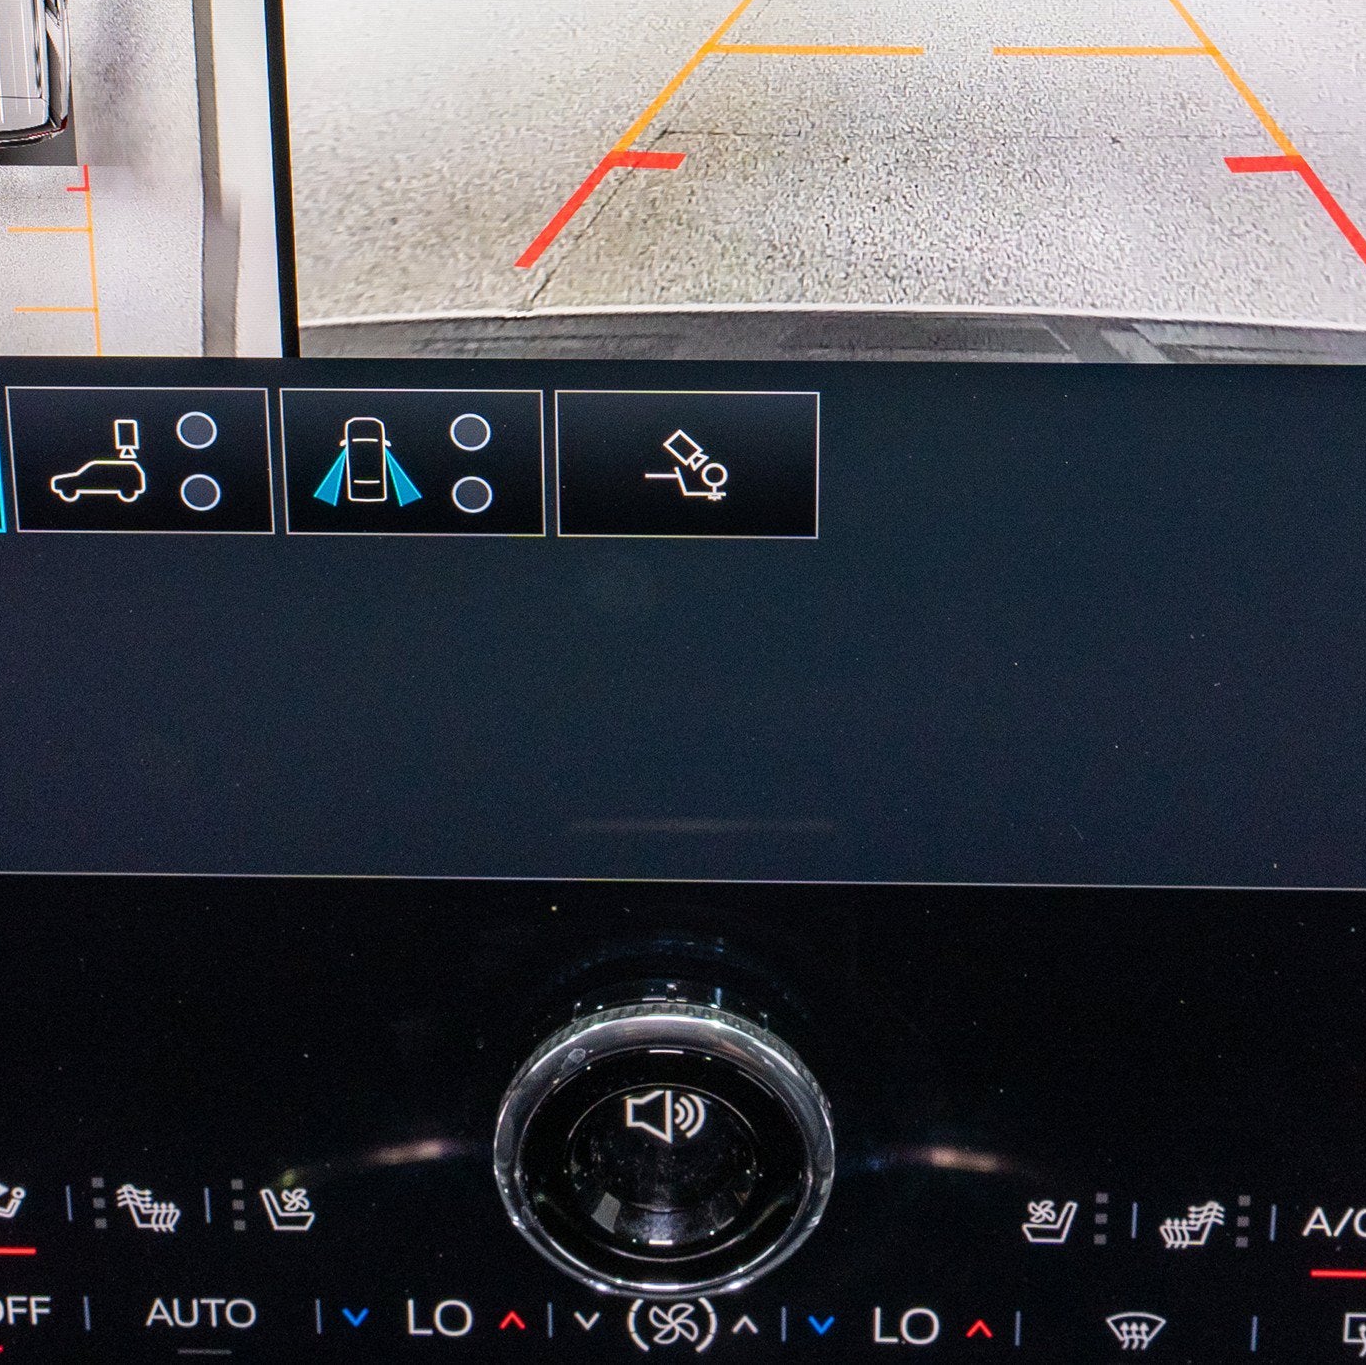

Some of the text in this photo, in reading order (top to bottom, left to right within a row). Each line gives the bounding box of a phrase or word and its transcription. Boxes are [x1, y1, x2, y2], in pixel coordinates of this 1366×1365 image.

[146, 1298, 256, 1328] AUTO
[408, 1299, 472, 1336] LO
[874, 1307, 939, 1344] LO
